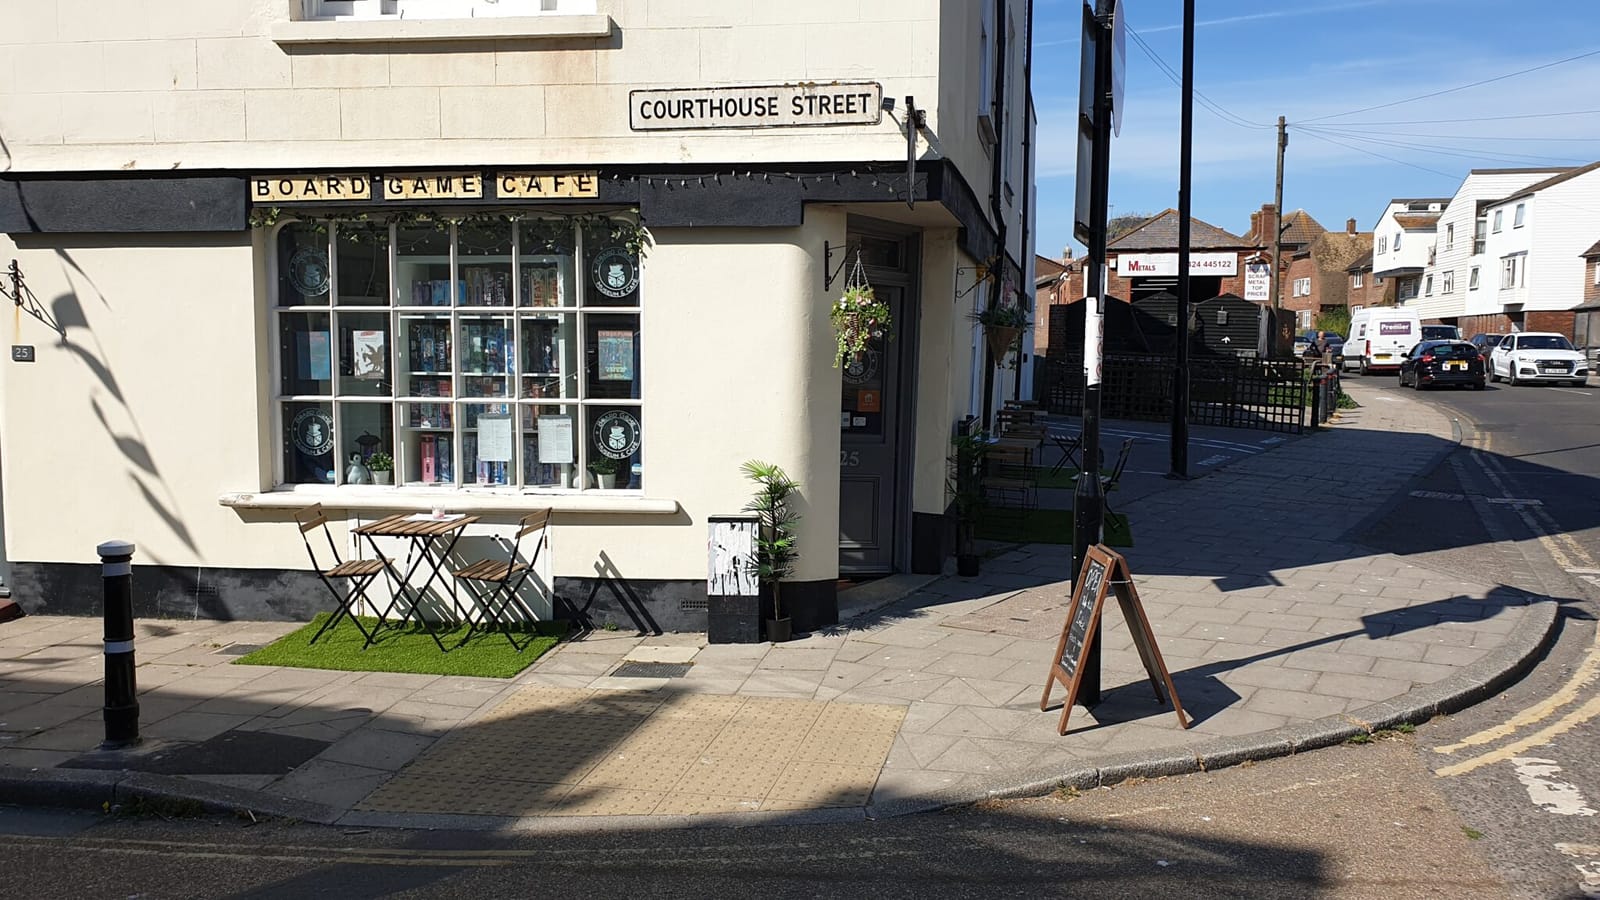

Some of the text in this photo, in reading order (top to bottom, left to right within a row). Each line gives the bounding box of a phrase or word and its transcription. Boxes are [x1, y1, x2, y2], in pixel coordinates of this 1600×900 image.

[640, 93, 872, 119] COURTHOUSE STREET
[256, 174, 592, 196] BOARD GAME CAFE
[1128, 260, 1156, 271] METALS
[1203, 260, 1232, 268] 445122
[1381, 323, 1410, 331] Premier
[15, 347, 28, 358] 25
